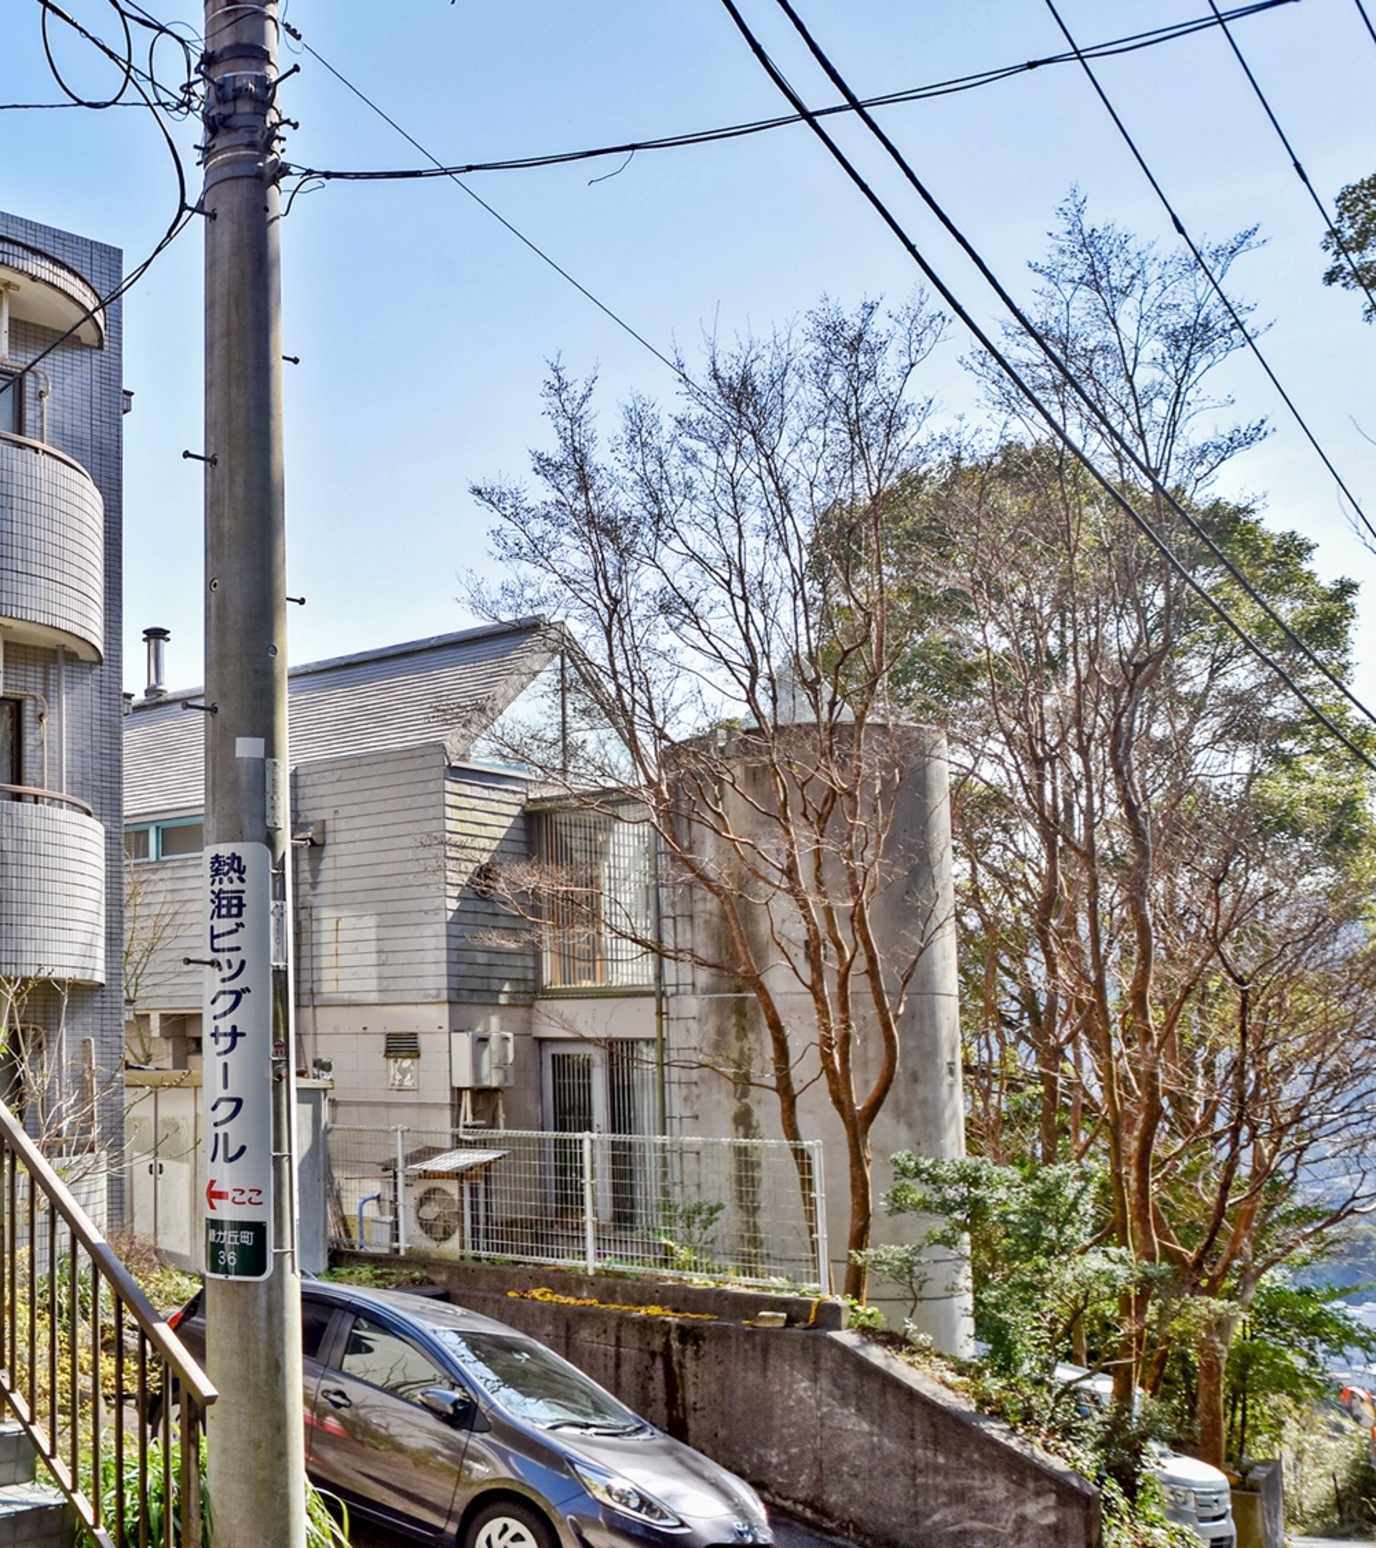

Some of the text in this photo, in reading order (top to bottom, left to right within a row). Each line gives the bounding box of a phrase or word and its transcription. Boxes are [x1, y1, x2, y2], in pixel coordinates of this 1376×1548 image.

[210, 852, 251, 1164] 熱海ビッグサークル
[231, 1188, 264, 1206] ここ
[218, 1250, 238, 1266] 36
